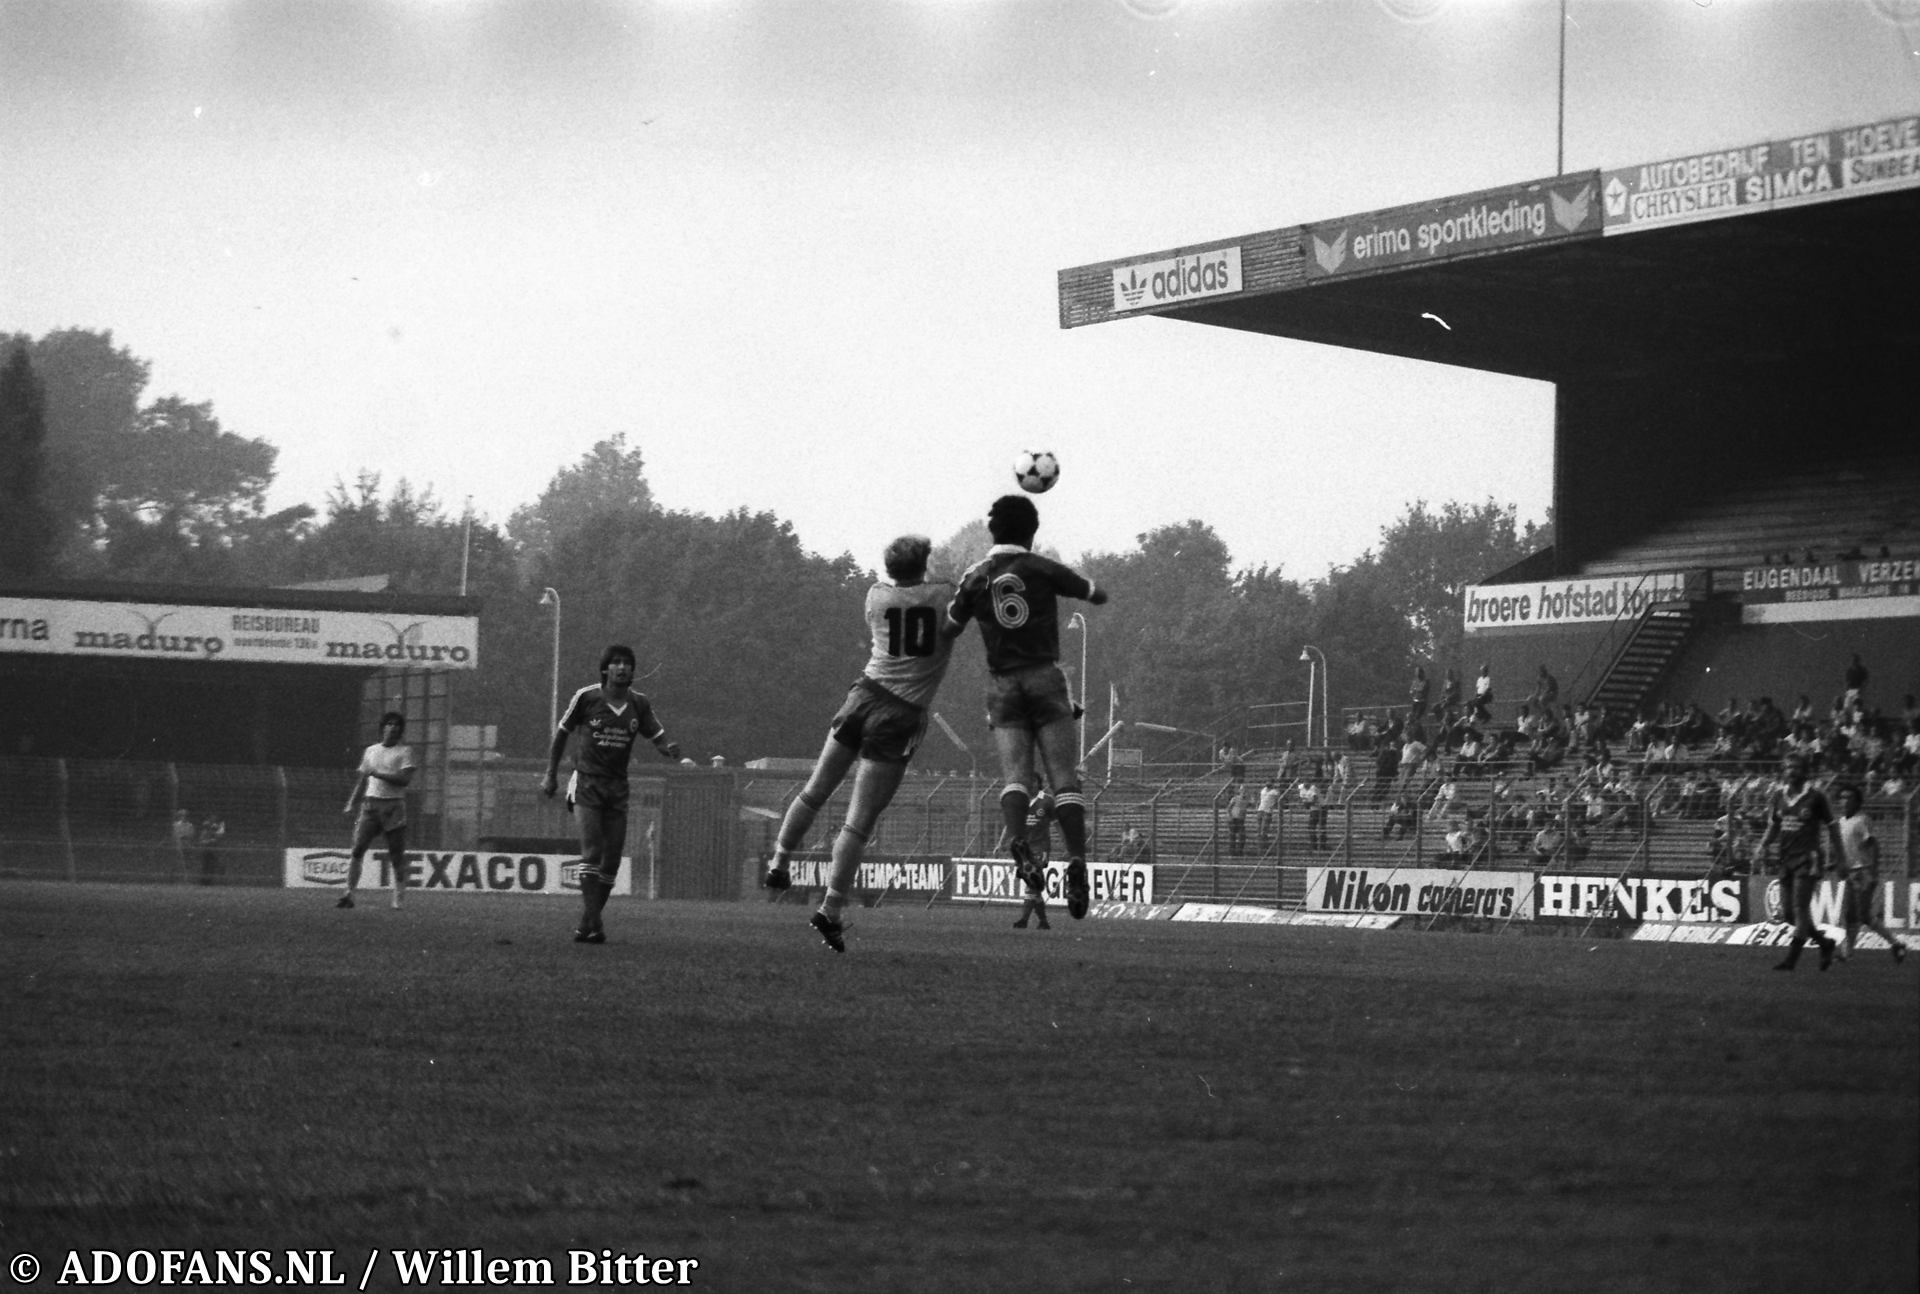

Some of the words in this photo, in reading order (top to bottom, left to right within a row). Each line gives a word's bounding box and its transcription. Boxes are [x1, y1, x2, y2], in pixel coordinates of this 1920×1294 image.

[1640, 145, 1769, 192] AUTOBEDRIJF
[1790, 136, 1830, 167] TEN
[1842, 120, 1919, 157] HOEVE
[1633, 181, 1733, 219] CHRYSLER
[1745, 163, 1833, 202] SIMCA
[1353, 226, 1410, 259] erima
[1417, 200, 1545, 254] sportkleding
[1152, 256, 1228, 299] adidas
[992, 573, 1029, 629] 6
[1467, 591, 1530, 623] broere
[1537, 581, 1618, 619] hofstad
[74, 625, 224, 654] maduro
[232, 615, 320, 633] REISBUREAU
[884, 607, 936, 657] 10
[326, 632, 470, 662] maduro
[304, 861, 349, 876] TEXAC
[373, 851, 547, 891] TEXACO
[860, 862, 944, 890] TEMPO-TEAM!
[1322, 870, 1411, 911] Nikon
[1417, 884, 1514, 917] camera's
[1539, 875, 1741, 923] HENKES
